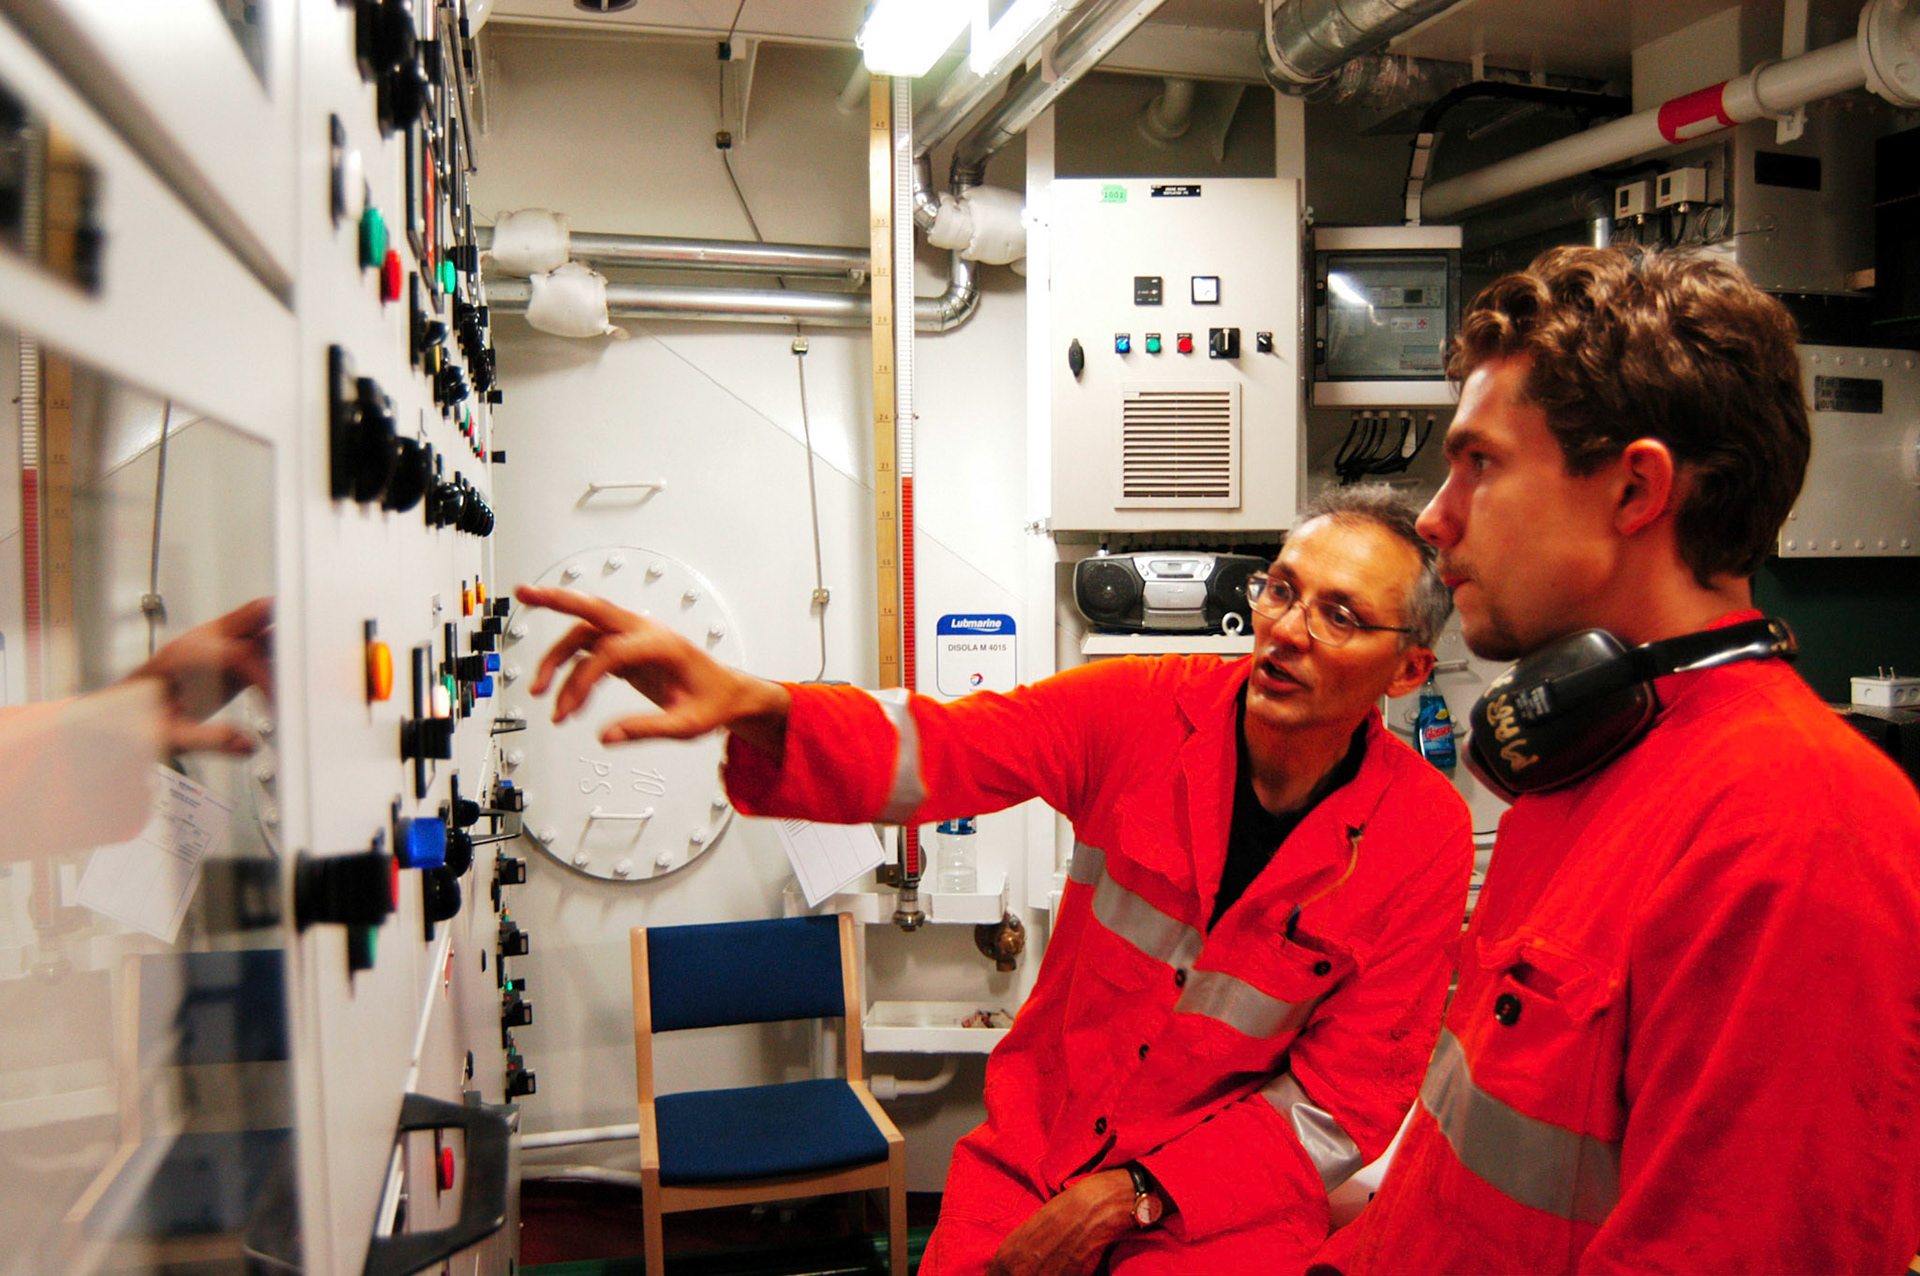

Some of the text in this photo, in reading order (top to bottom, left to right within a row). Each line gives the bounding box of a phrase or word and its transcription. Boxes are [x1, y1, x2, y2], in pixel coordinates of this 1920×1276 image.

[1103, 191, 1124, 199] 1001
[951, 618, 1002, 630] Lubmarine
[948, 644, 1007, 652] DISOLA M 4015
[578, 756, 613, 796] PS
[630, 767, 667, 797] 10
